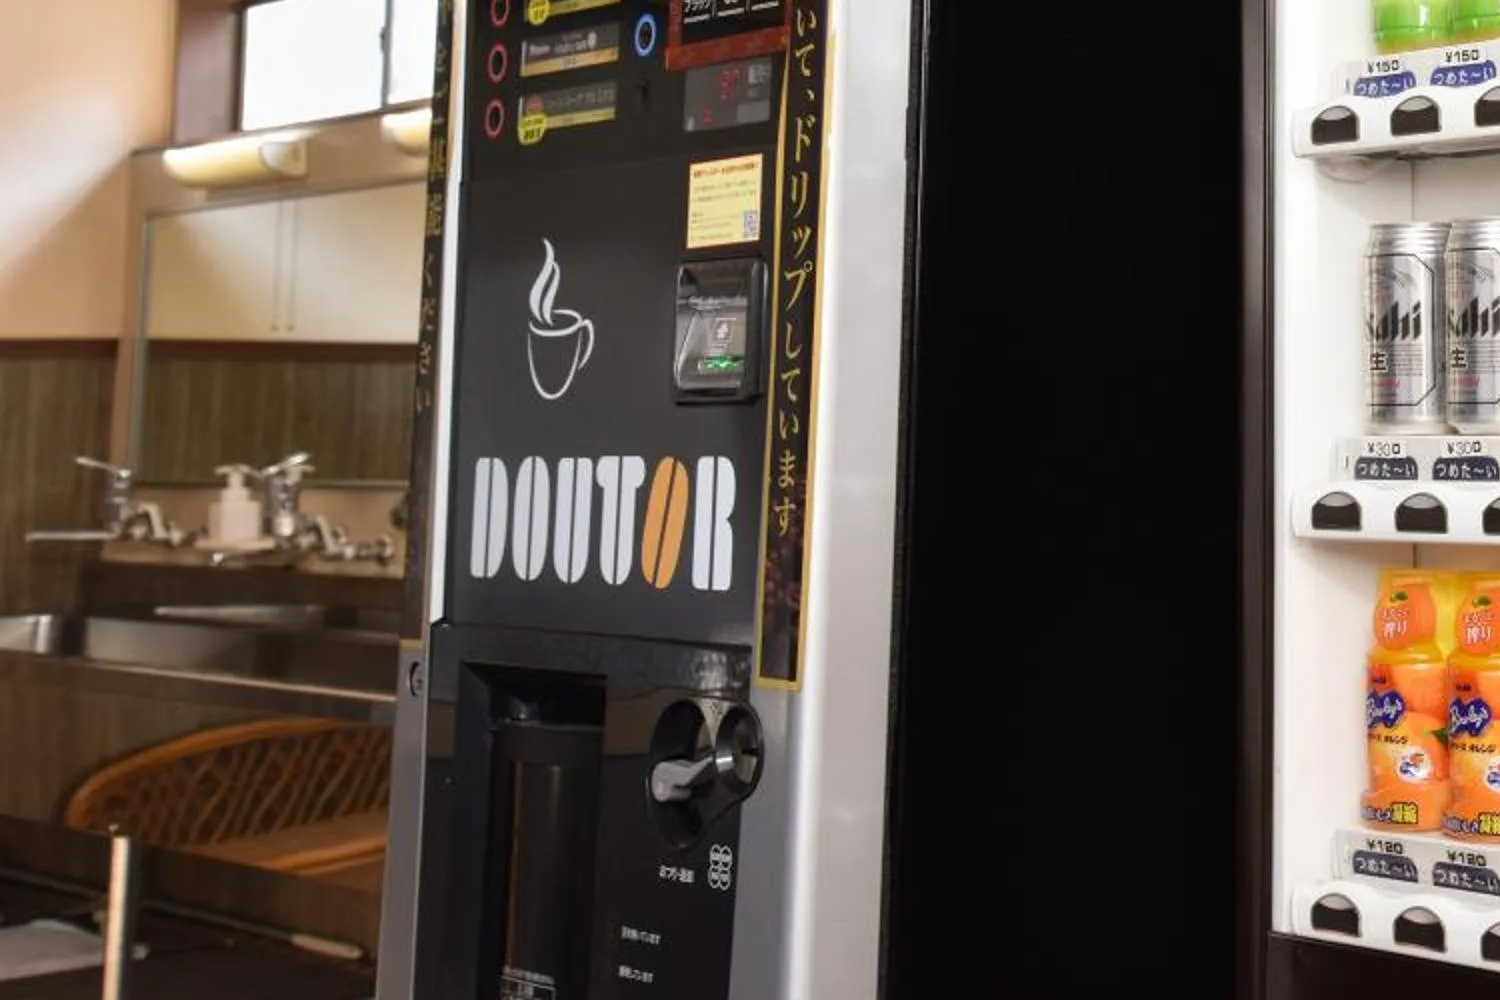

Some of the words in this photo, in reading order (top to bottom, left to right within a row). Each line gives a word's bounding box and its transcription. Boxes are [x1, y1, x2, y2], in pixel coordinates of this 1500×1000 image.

[1445, 50, 1480, 63] ¥150
[1367, 60, 1399, 73] ¥150
[470, 455, 736, 590] DOUTOR
